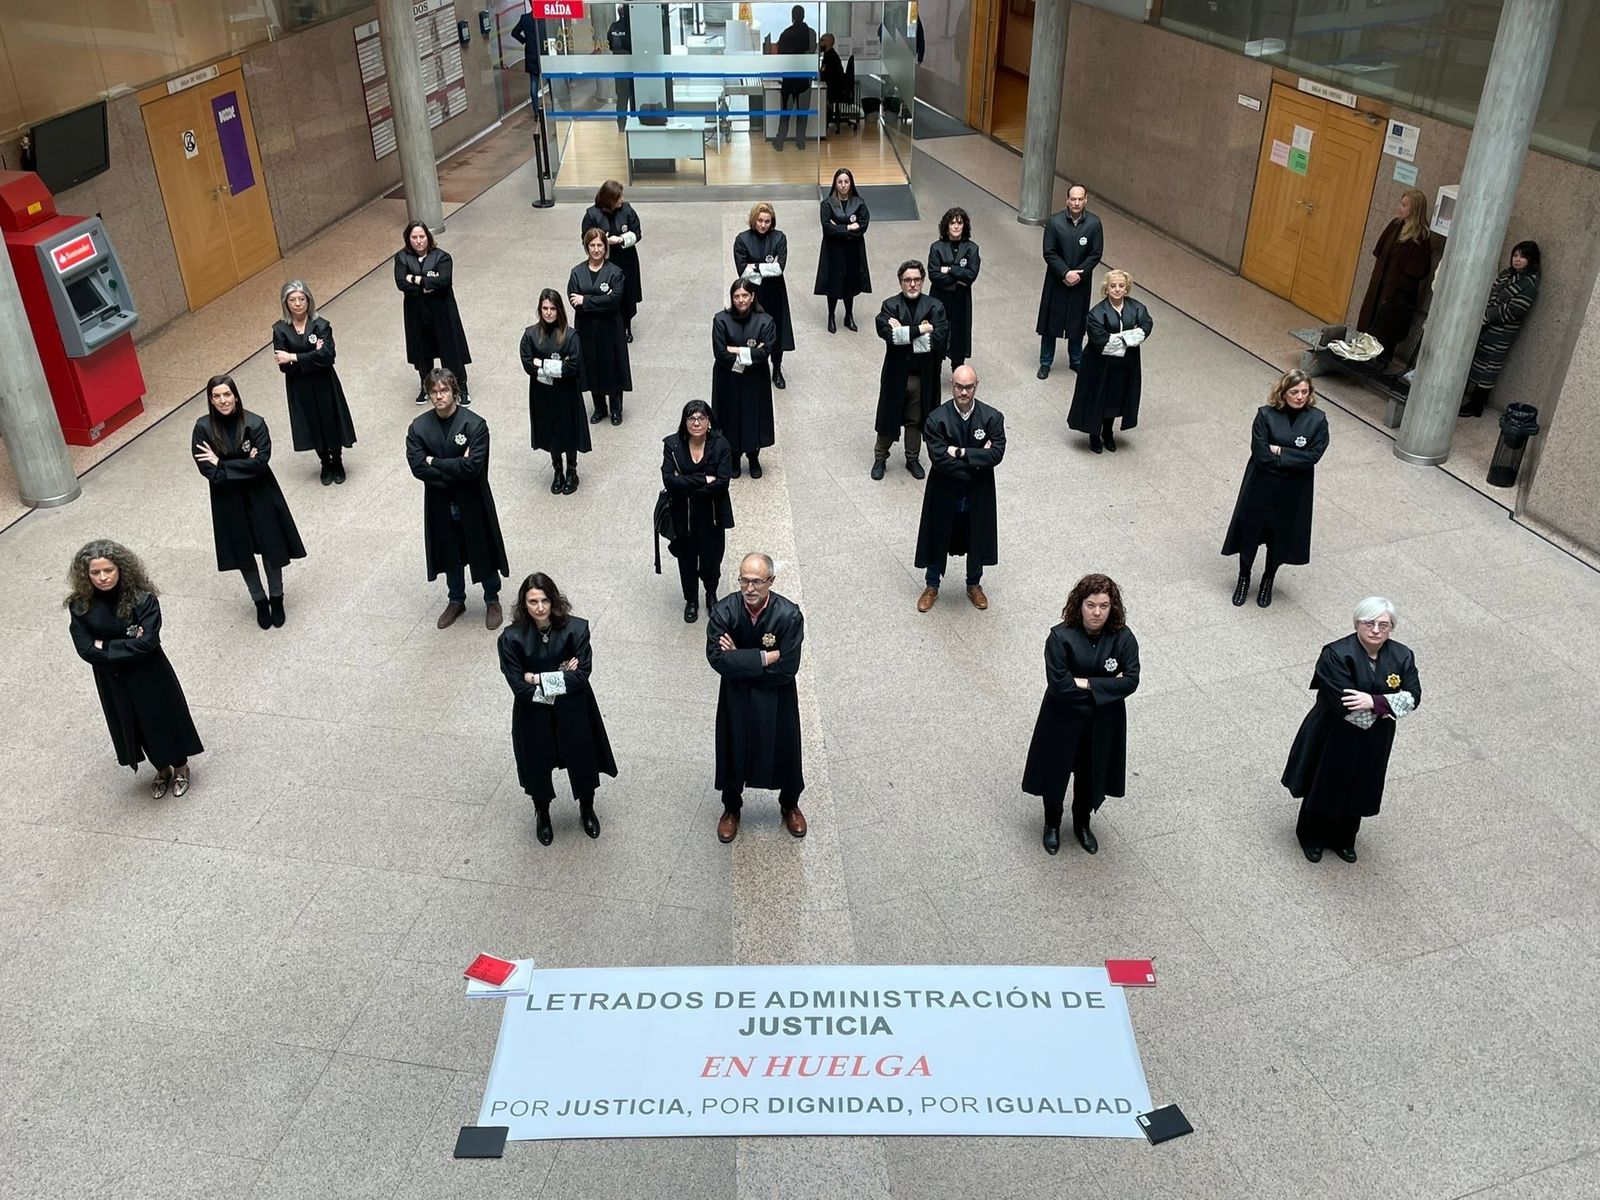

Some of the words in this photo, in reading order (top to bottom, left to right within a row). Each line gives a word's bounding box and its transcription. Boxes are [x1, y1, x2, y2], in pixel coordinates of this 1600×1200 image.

[544, 1, 572, 15] SAÍDA
[525, 991, 703, 1012] LETRADOS
[714, 991, 756, 1010] DE
[764, 986, 1052, 1009] ADMINISTRACIÓN
[1062, 991, 1106, 1009] DE
[738, 1015, 893, 1037] JUSTICIA
[699, 1054, 757, 1078] EN
[762, 1054, 933, 1078] HUELGA
[490, 1100, 549, 1118] POR
[556, 1098, 692, 1120] JUSTICIA,
[702, 1097, 759, 1116] POR
[768, 1096, 913, 1117] DIGNIDAD,
[921, 1096, 980, 1114] POR
[986, 1096, 1142, 1115] IGUALDAD.
